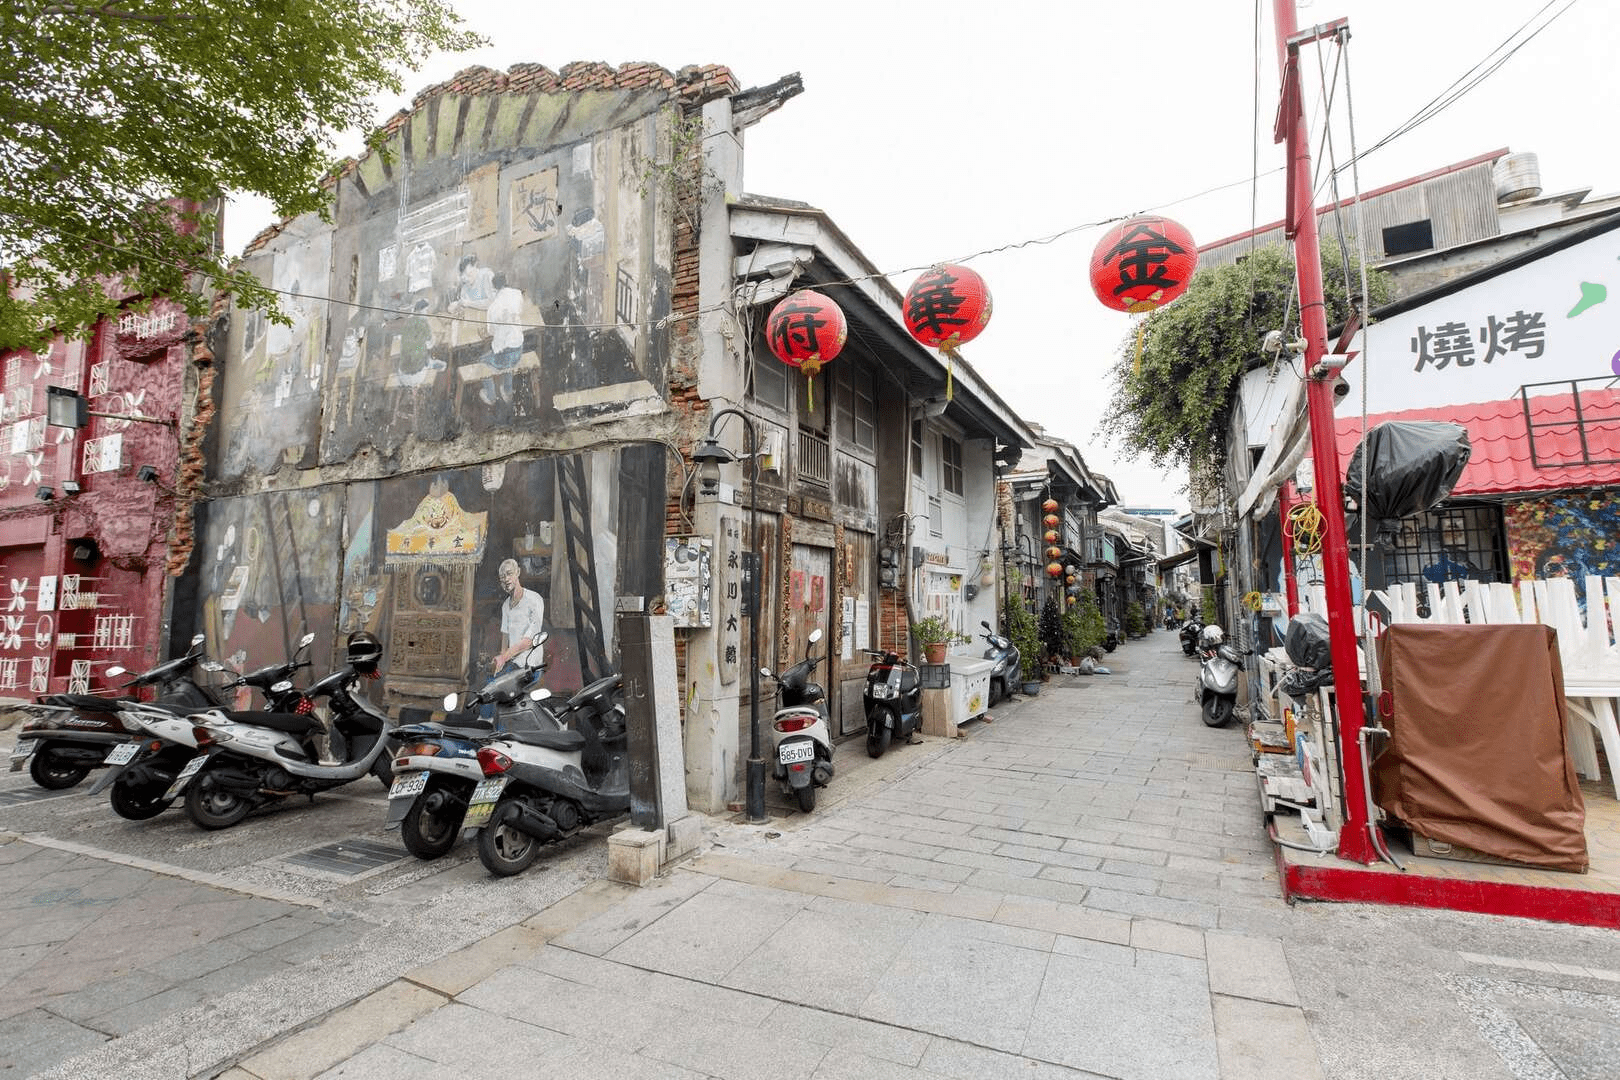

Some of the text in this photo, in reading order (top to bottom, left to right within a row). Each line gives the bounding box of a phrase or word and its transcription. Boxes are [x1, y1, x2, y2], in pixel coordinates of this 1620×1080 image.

[1103, 225, 1185, 296] 金
[771, 304, 827, 355] 府
[908, 271, 971, 334] 華
[1411, 310, 1546, 372] 燒烤
